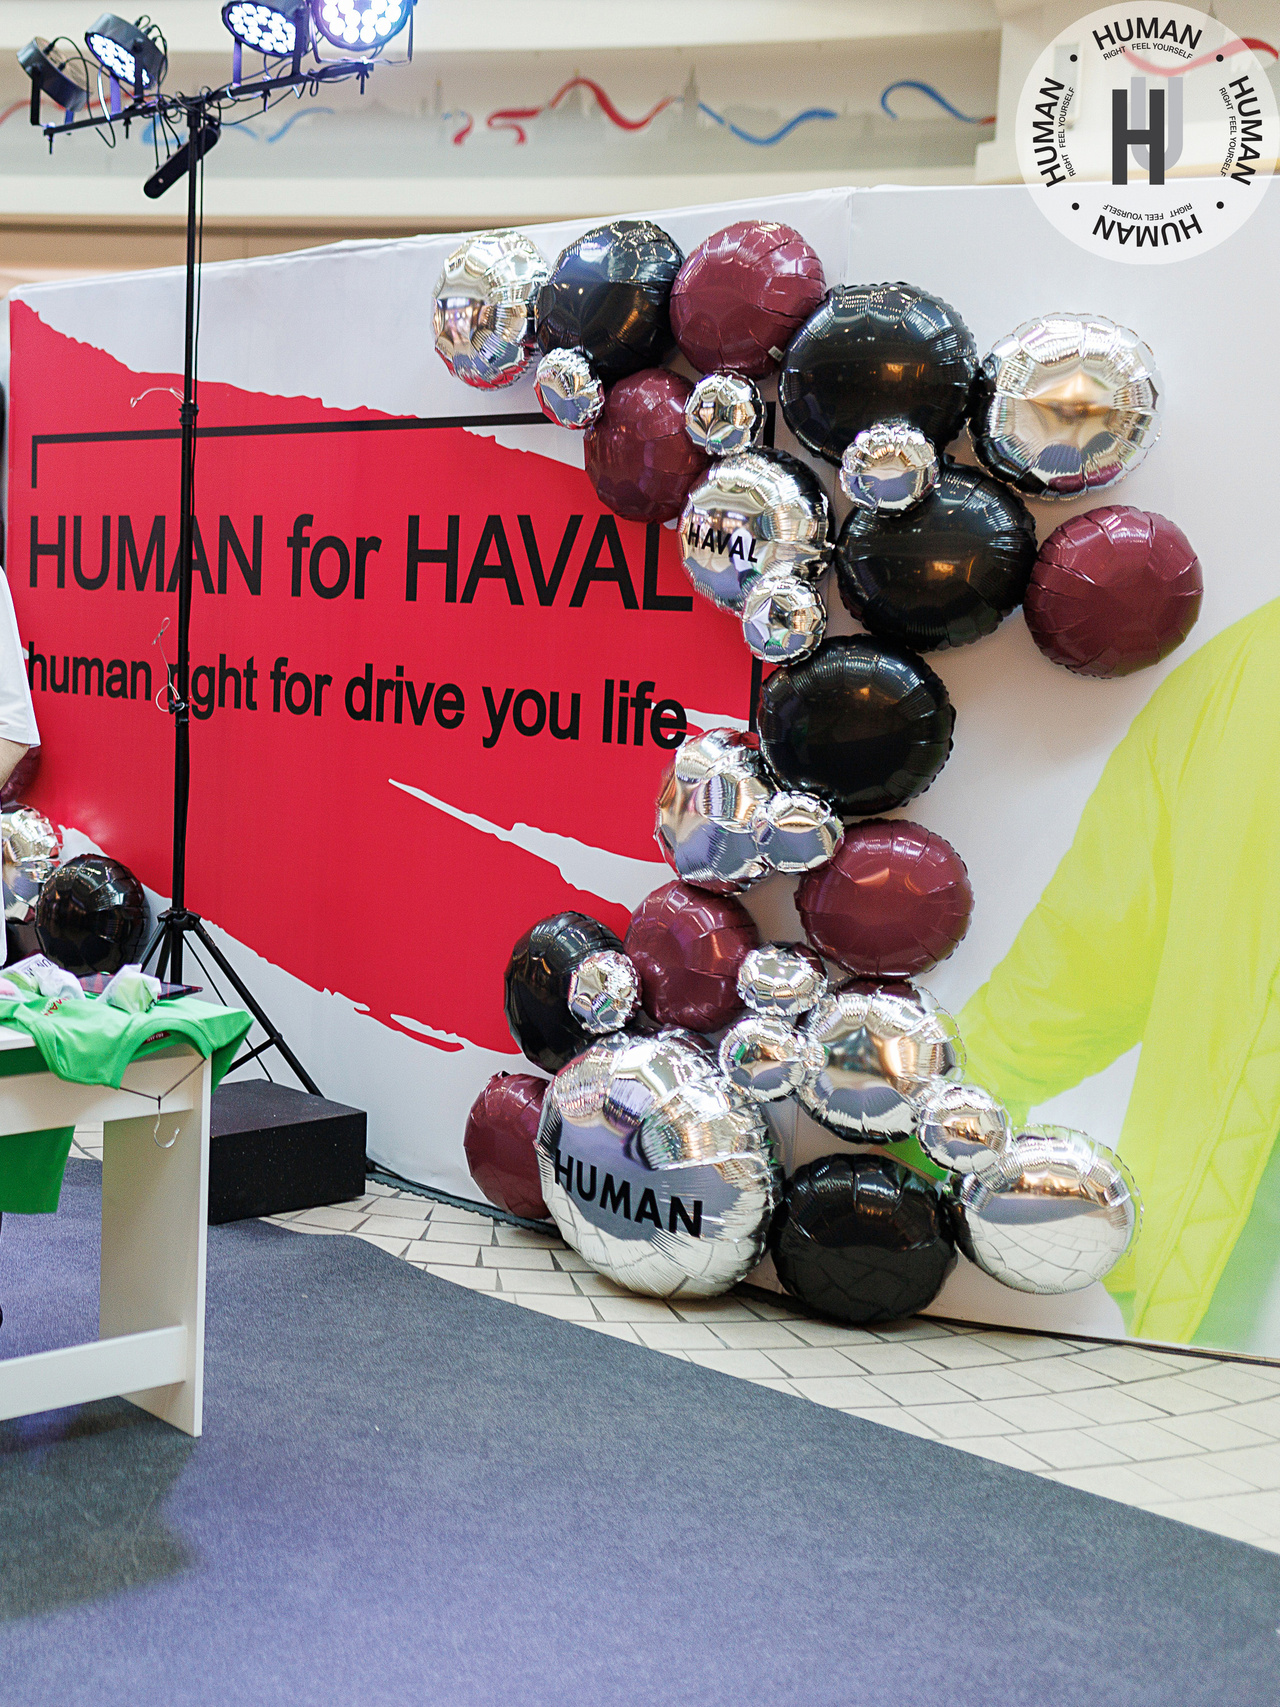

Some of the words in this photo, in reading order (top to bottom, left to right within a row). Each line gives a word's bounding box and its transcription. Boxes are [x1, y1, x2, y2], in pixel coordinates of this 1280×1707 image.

[29, 514, 263, 596] HUMAN
[287, 513, 382, 600] for
[405, 514, 694, 612] HAVAL
[687, 521, 758, 563] HAVAL
[28, 641, 152, 701] human
[168, 653, 258, 720] rght
[270, 657, 332, 718] for
[344, 663, 465, 729] drive
[482, 686, 581, 749] you
[601, 679, 688, 750] life
[554, 1148, 703, 1239] HUMAN
